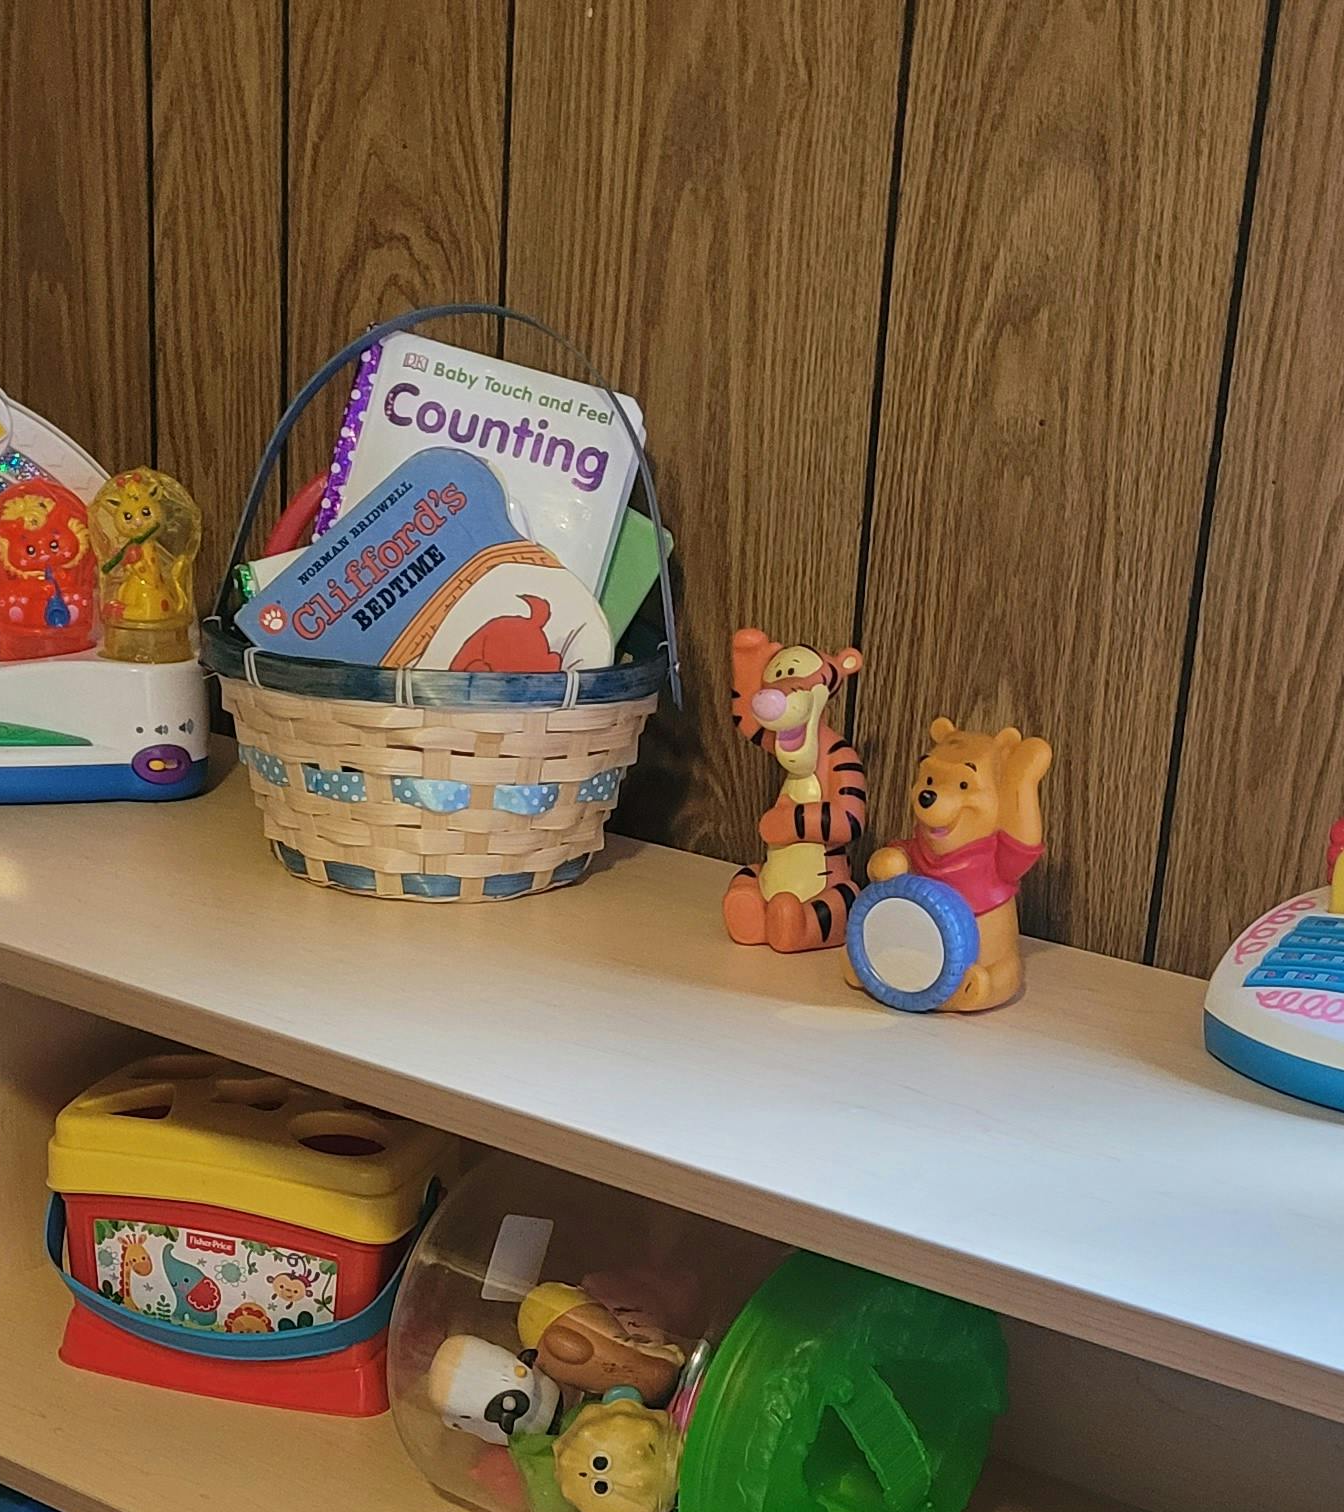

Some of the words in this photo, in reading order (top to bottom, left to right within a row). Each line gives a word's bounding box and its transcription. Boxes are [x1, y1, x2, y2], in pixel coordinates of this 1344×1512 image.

[384, 382, 609, 492] Counting
[406, 354, 426, 370] DK
[434, 362, 478, 390] Baby
[485, 376, 532, 402] Touch
[538, 395, 574, 414] and
[577, 403, 615, 426] Feel
[292, 482, 468, 640] Clifford's
[297, 536, 350, 585] NORMAN
[349, 481, 413, 539] BRIDWELL
[352, 544, 446, 631] BEDTIME
